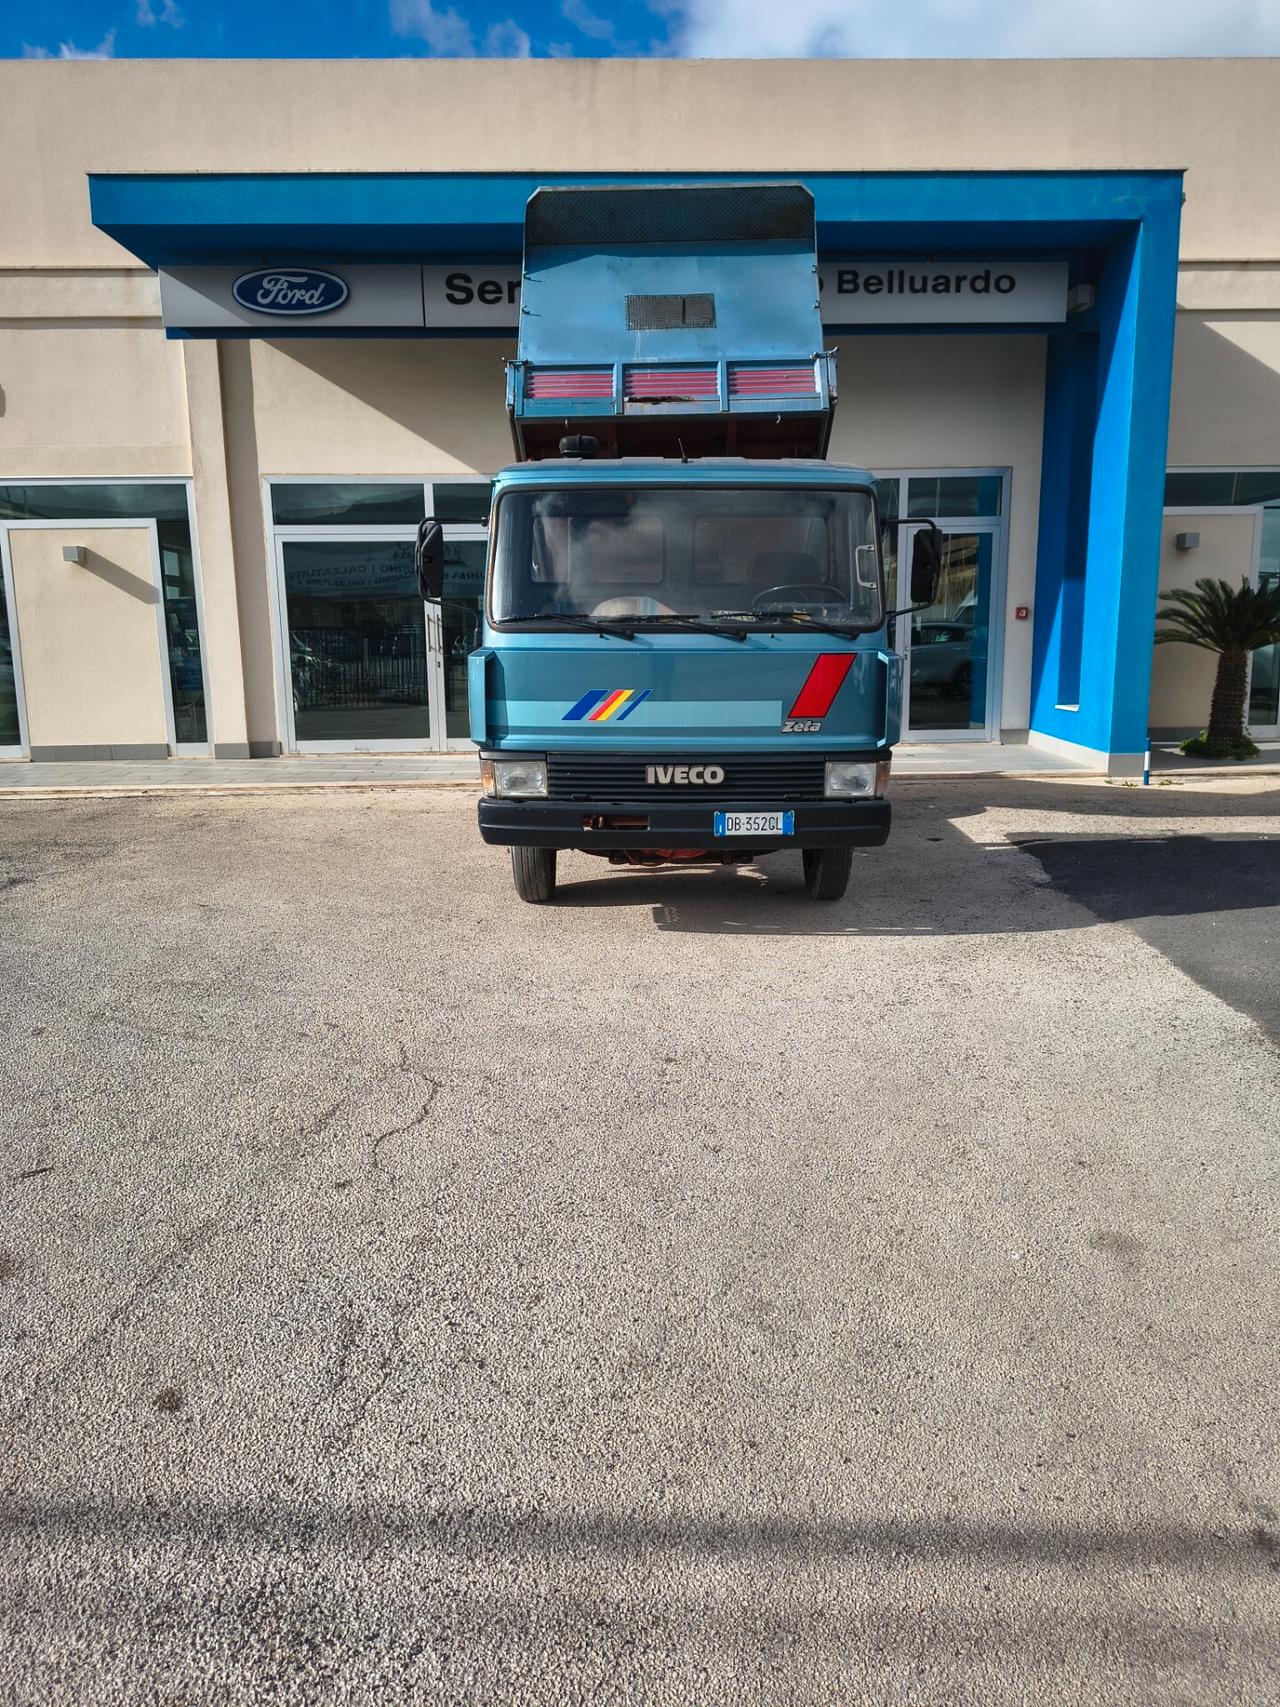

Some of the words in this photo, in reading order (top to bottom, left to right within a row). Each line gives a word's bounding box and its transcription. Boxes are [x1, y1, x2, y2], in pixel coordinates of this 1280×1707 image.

[256, 275, 325, 304] Ford
[445, 272, 521, 305] Ser
[837, 269, 1016, 294] Belluardo
[781, 720, 822, 733] Zeta
[646, 765, 725, 784] IVECO
